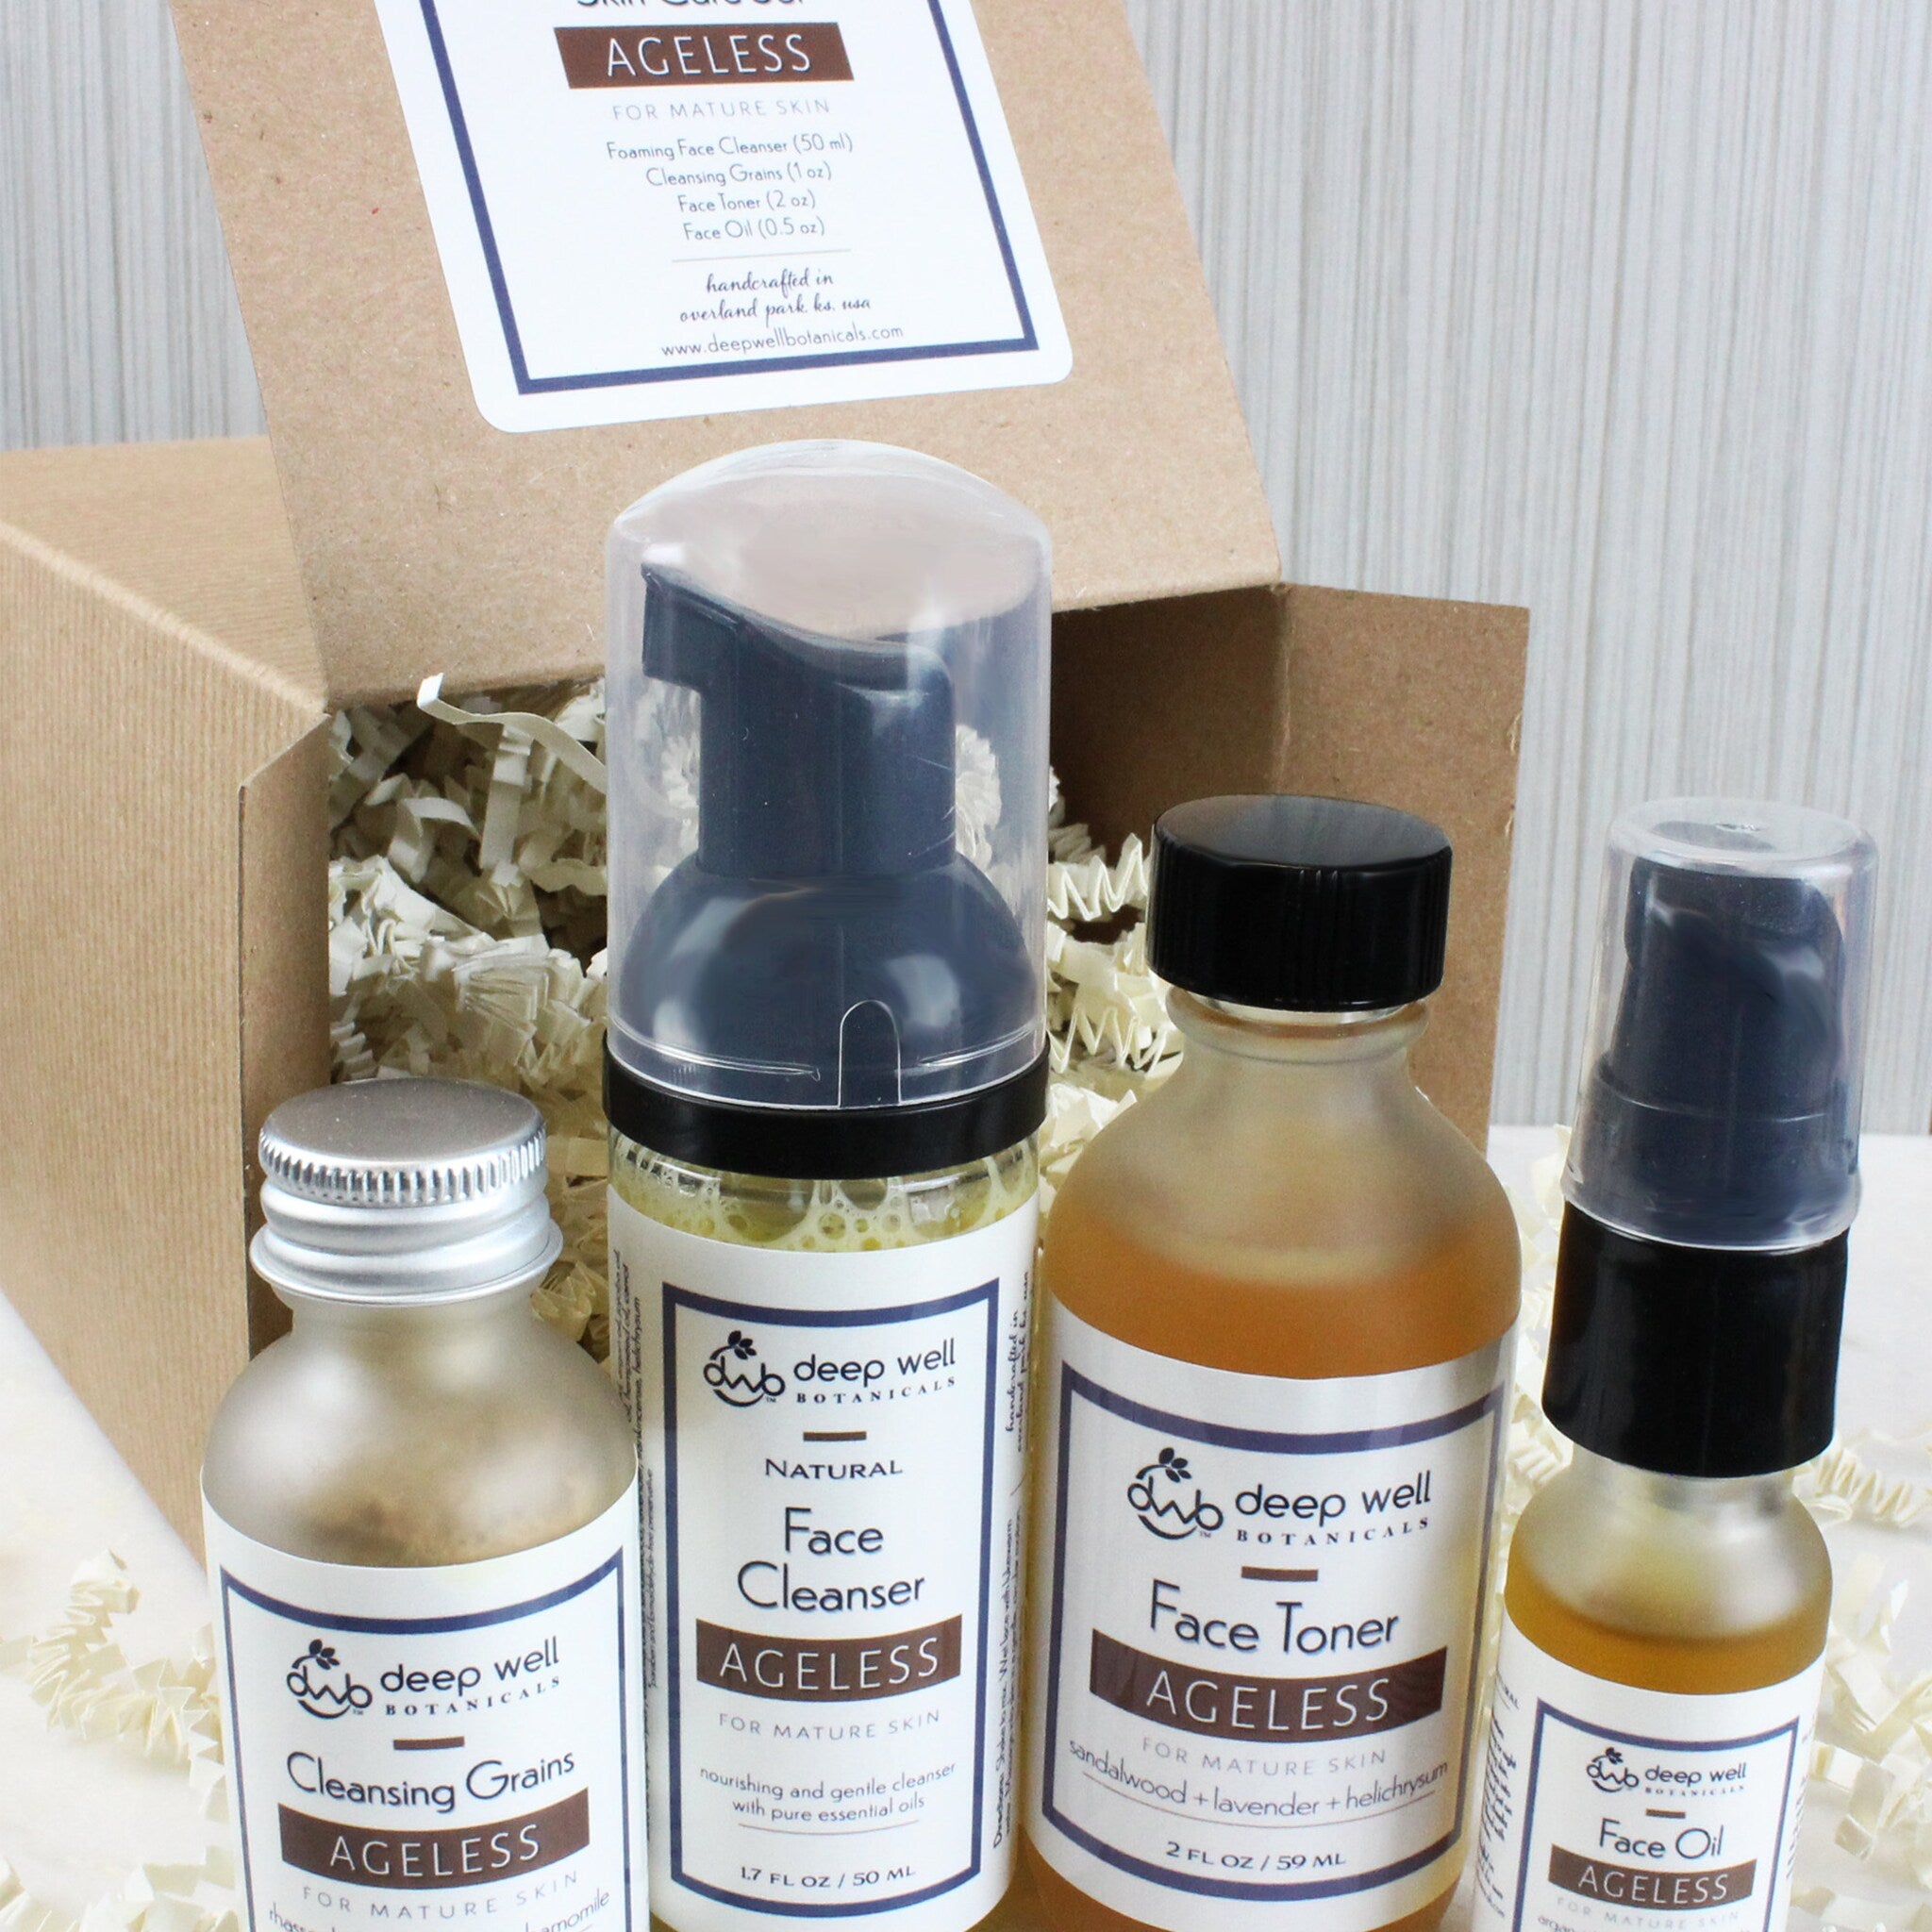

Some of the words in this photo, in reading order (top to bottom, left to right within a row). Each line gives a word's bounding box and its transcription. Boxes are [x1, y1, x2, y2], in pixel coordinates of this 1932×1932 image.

[607, 34, 811, 77] AGELESS
[612, 103, 658, 121] FOR
[669, 99, 768, 119] MATURE
[775, 98, 832, 117] SKIN
[606, 141, 675, 162] Foaming
[676, 138, 715, 158] Face
[718, 136, 788, 156] Cleanser
[792, 132, 825, 156] (50
[828, 132, 854, 154] ml)
[645, 167, 726, 188] Cleansing
[728, 162, 784, 183] Grains
[786, 161, 803, 183] (1
[806, 160, 833, 181] oz)
[676, 194, 716, 214] Face
[717, 192, 761, 210] Toner
[766, 190, 786, 212] (2
[791, 189, 817, 209] oz)
[683, 222, 722, 242] Face
[724, 219, 754, 239] Oil
[757, 217, 796, 241] (0.5
[799, 215, 826, 237] oz)
[706, 267, 810, 299] handcrafted
[815, 268, 835, 286] in
[679, 297, 758, 324] overland
[841, 298, 872, 311] usa
[660, 322, 905, 357] www.deepwellbotanicals.com
[793, 1353, 885, 1389] deep
[896, 1337, 956, 1375] well
[796, 1375, 957, 1405] BOTANICALS
[1005, 1334, 1022, 1433] handcrafted
[765, 1457, 903, 1480] NATURAL
[1234, 1483, 1346, 1528] deep
[1361, 1469, 1431, 1515] well
[784, 1506, 884, 1556] Face
[1236, 1517, 1430, 1546] BOTANICALS
[737, 1559, 925, 1613] Cleanser
[1149, 1577, 1260, 1651] Face
[1274, 1600, 1400, 1655] Toner
[379, 1662, 482, 1697] deep
[493, 1635, 560, 1682] well
[719, 1636, 939, 1691] AGELESS
[384, 1677, 561, 1716] BOTANICALS
[1145, 1669, 1390, 1731] AGELESS
[719, 1712, 761, 1735] FOR
[774, 1723, 876, 1741] MATURE
[888, 1708, 941, 1735] SKIN
[1141, 1736, 1189, 1764] FOR
[1201, 1754, 1316, 1777] MATURE
[1327, 1748, 1387, 1774] SKIN
[1644, 1764, 1702, 1788] deep
[1709, 1761, 1747, 1783] well
[286, 1750, 456, 1814] Cleansing
[465, 1750, 575, 1801] Grains
[700, 1767, 784, 1801] nourishing
[790, 1780, 824, 1799] and
[829, 1777, 887, 1803] gentle
[891, 1761, 957, 1792] cleanser
[1068, 1738, 1188, 1805] sandalwood
[1194, 1793, 1209, 1807] +
[1213, 1788, 1321, 1818] lavender
[1328, 1797, 1341, 1811] +
[1345, 1759, 1449, 1809] helichrysum
[1644, 1784, 1745, 1797] BOTANICALS
[732, 1797, 766, 1817] with
[771, 1807, 812, 1828] pure
[818, 1797, 893, 1823] essential
[898, 1790, 925, 1813] oils
[328, 1823, 541, 1878] AGELESS
[1165, 1840, 1181, 1858] 2
[1187, 1848, 1214, 1866] FL
[1221, 1853, 1255, 1869] OZ
[1260, 1854, 1270, 1870] /
[1275, 1854, 1307, 1870] 59
[1311, 1851, 1347, 1867] ML
[1598, 1817, 1666, 1858] Face
[1675, 1824, 1724, 1859] Oil
[740, 1865, 762, 1882] 1.7
[769, 1873, 794, 1887] FL
[801, 1874, 831, 1888] OZ
[837, 1874, 846, 1889] /
[852, 1870, 880, 1887] 50
[886, 1864, 916, 1881] ML
[1577, 1865, 1729, 1905] AGELESS
[303, 1886, 352, 1913] FOR
[371, 1897, 497, 1921] MATURE
[516, 1872, 578, 1907] SKIN
[1557, 1896, 1592, 1917] FOR
[1604, 1911, 1686, 1931] MATURE
[1699, 1910, 1740, 1927] SKIN
